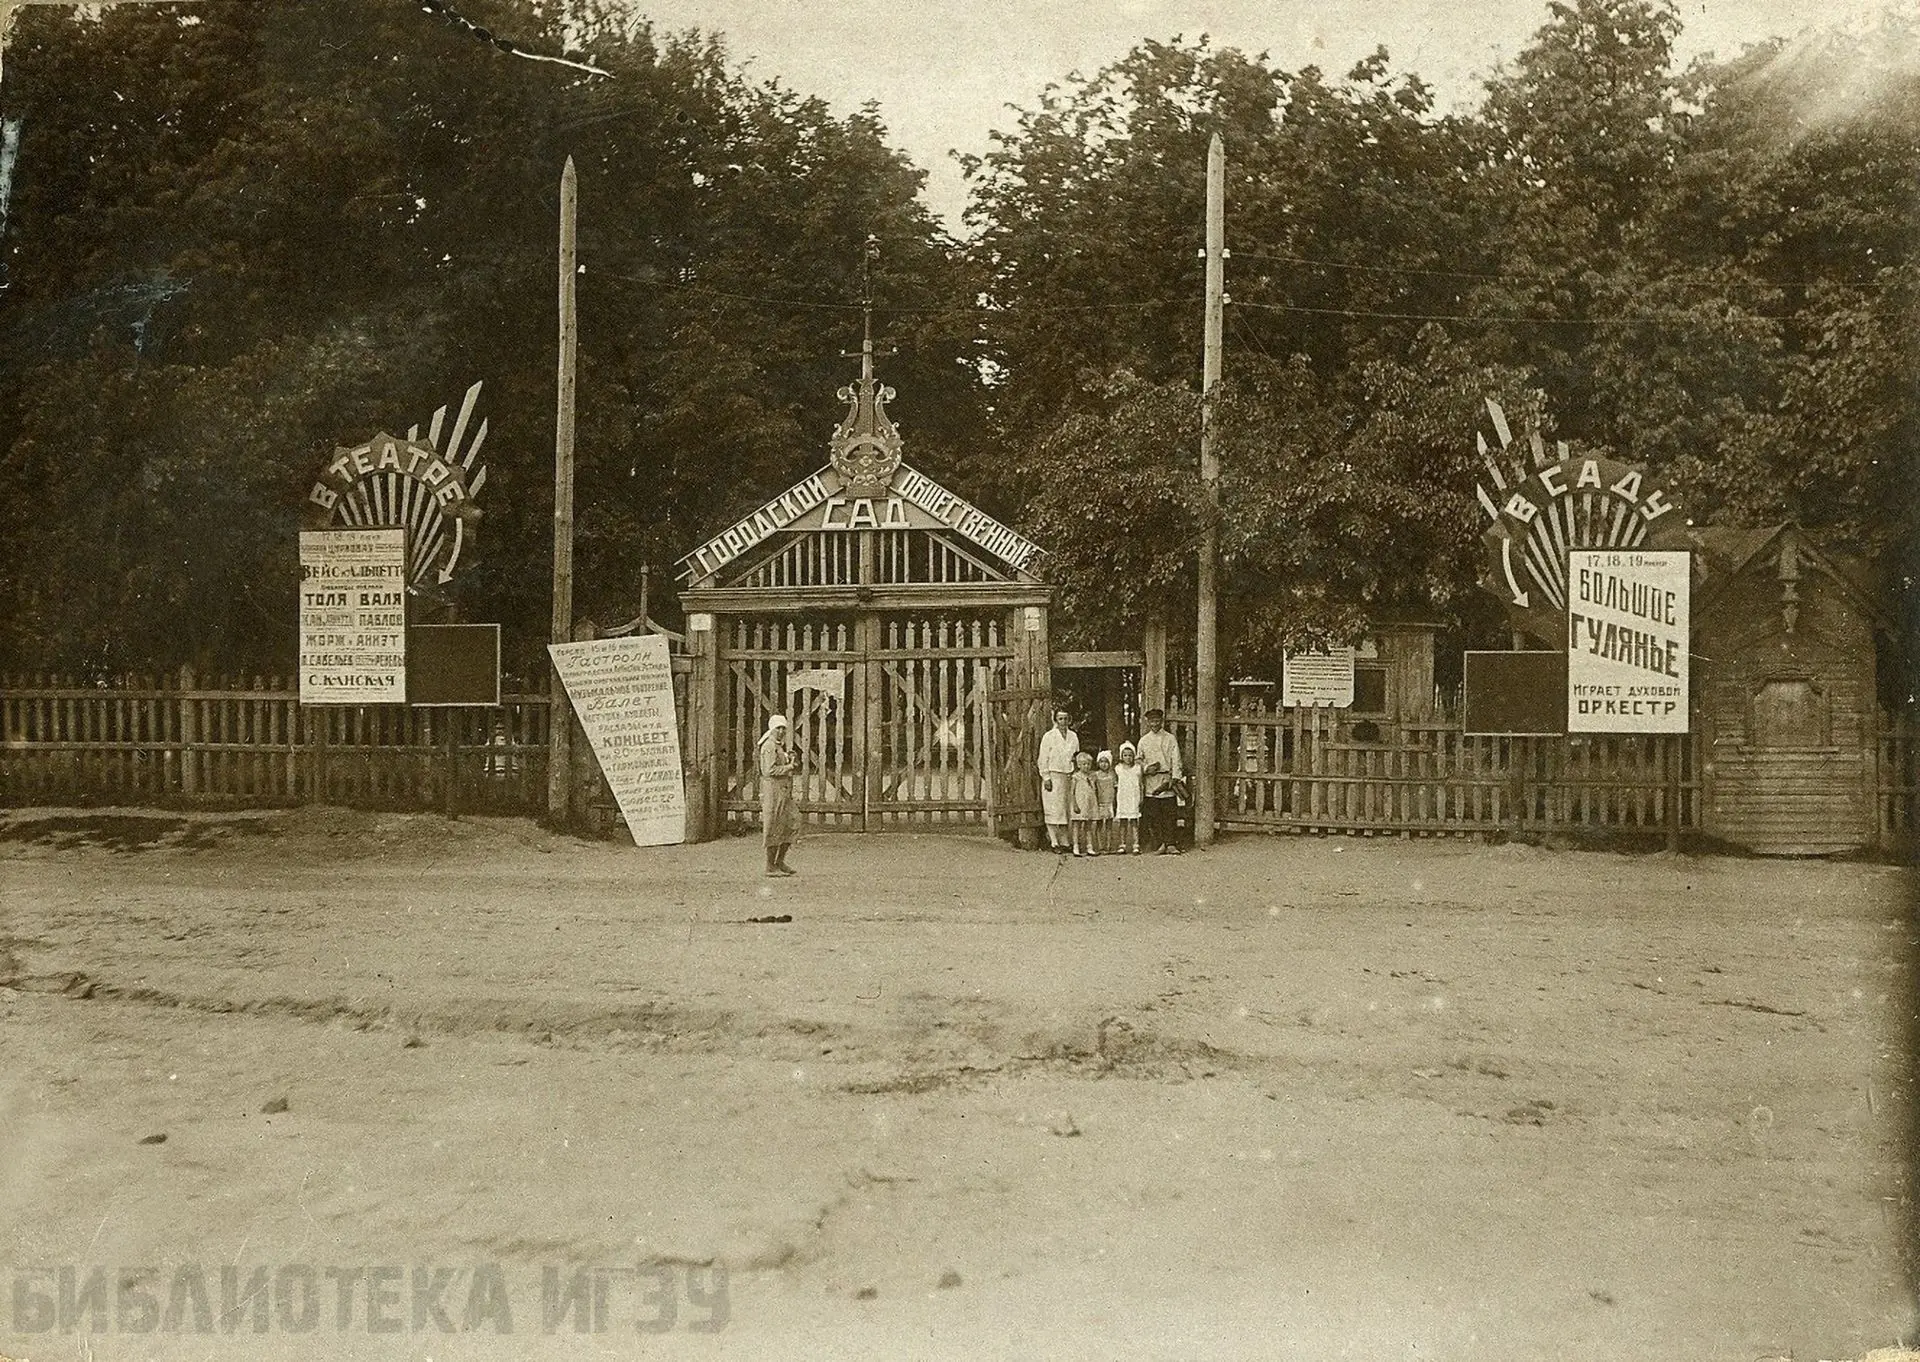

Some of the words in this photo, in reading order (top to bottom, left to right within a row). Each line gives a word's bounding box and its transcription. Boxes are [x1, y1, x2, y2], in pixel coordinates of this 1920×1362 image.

[309, 481, 338, 509] В
[329, 442, 465, 507] ТЕАТРЕ
[1505, 493, 1538, 523] В
[1539, 460, 1674, 521] САДУ
[822, 498, 911, 528] САД
[1629, 554, 1643, 567] 19
[304, 593, 347, 606] ТОЛЯ
[360, 593, 402, 606] ВАЛЯ
[1580, 568, 1676, 626] БОЛЬШОЕ
[360, 614, 403, 627] ПАВЛОВ
[305, 634, 346, 647] ЖОРЖ
[1571, 612, 1679, 678] ГУЛЯНЬЕ
[1573, 684, 1621, 696] ИГРАЕТ
[1628, 683, 1681, 697] ДУХОВОЙ
[586, 696, 656, 711] Балет
[1578, 699, 1676, 715] ОРКЕСТР
[602, 731, 669, 748] КОНЦЕРТ
